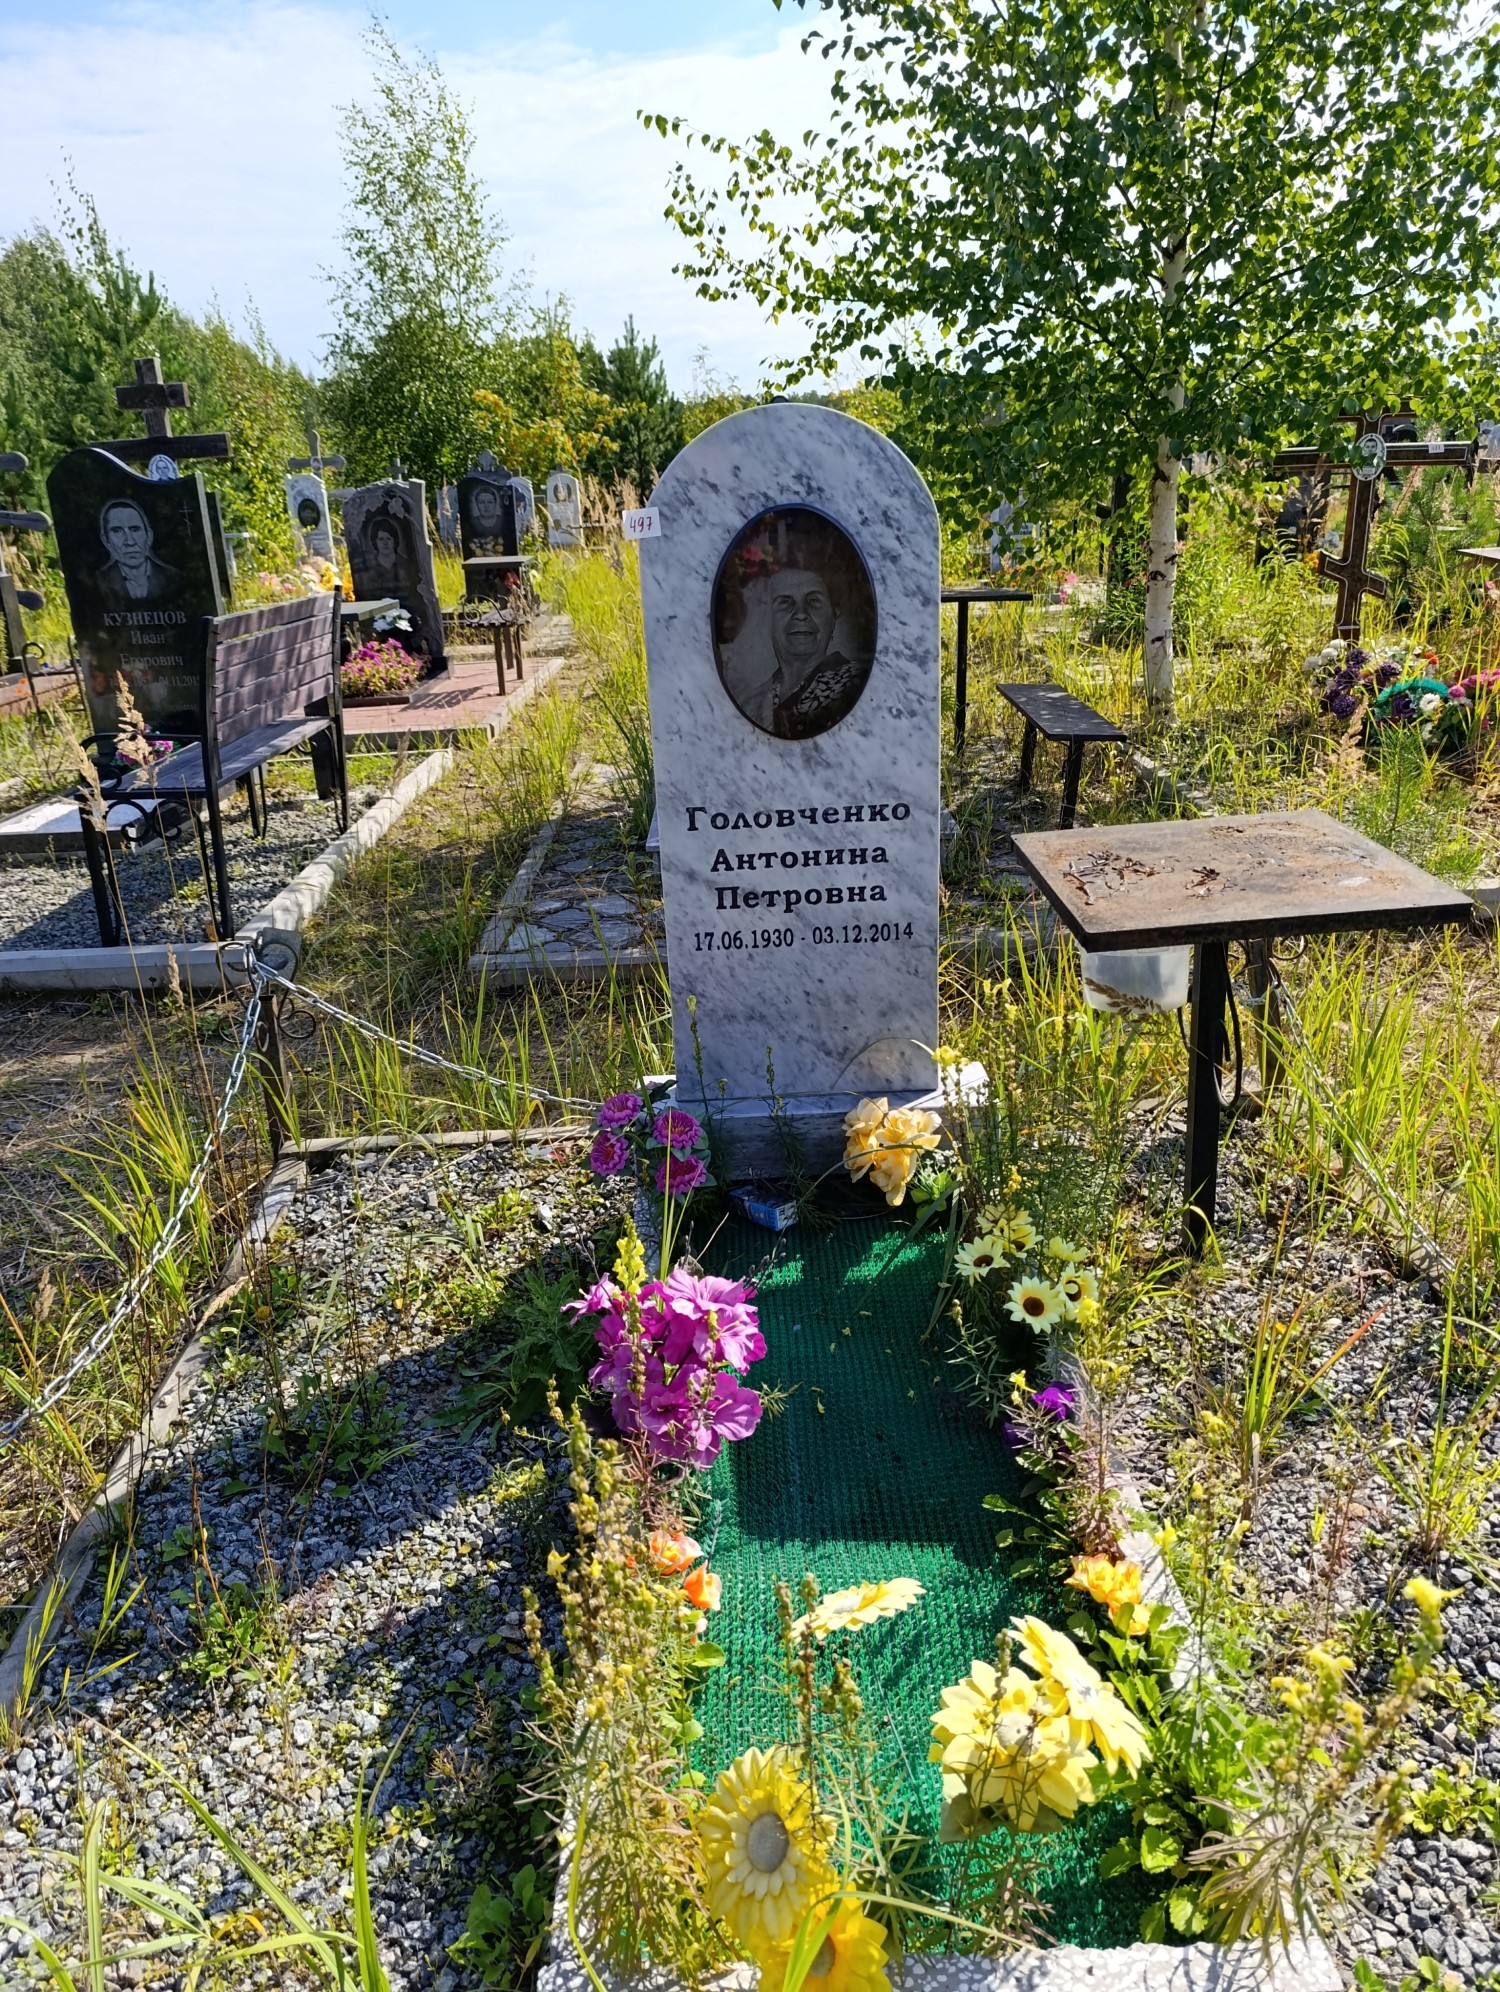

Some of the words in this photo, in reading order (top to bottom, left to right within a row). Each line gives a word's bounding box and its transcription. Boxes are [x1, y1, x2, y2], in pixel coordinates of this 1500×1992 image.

[629, 516, 653, 533] 497
[103, 610, 187, 628] КУЗНЕЦОВ
[130, 630, 166, 645] Иван
[120, 653, 184, 669] Егорович
[685, 802, 911, 832] Головченко
[710, 846, 889, 872] Антонина
[715, 884, 887, 913] Петровна
[694, 928, 794, 951] 17.06.1930
[812, 922, 914, 945] 03.12.2014
